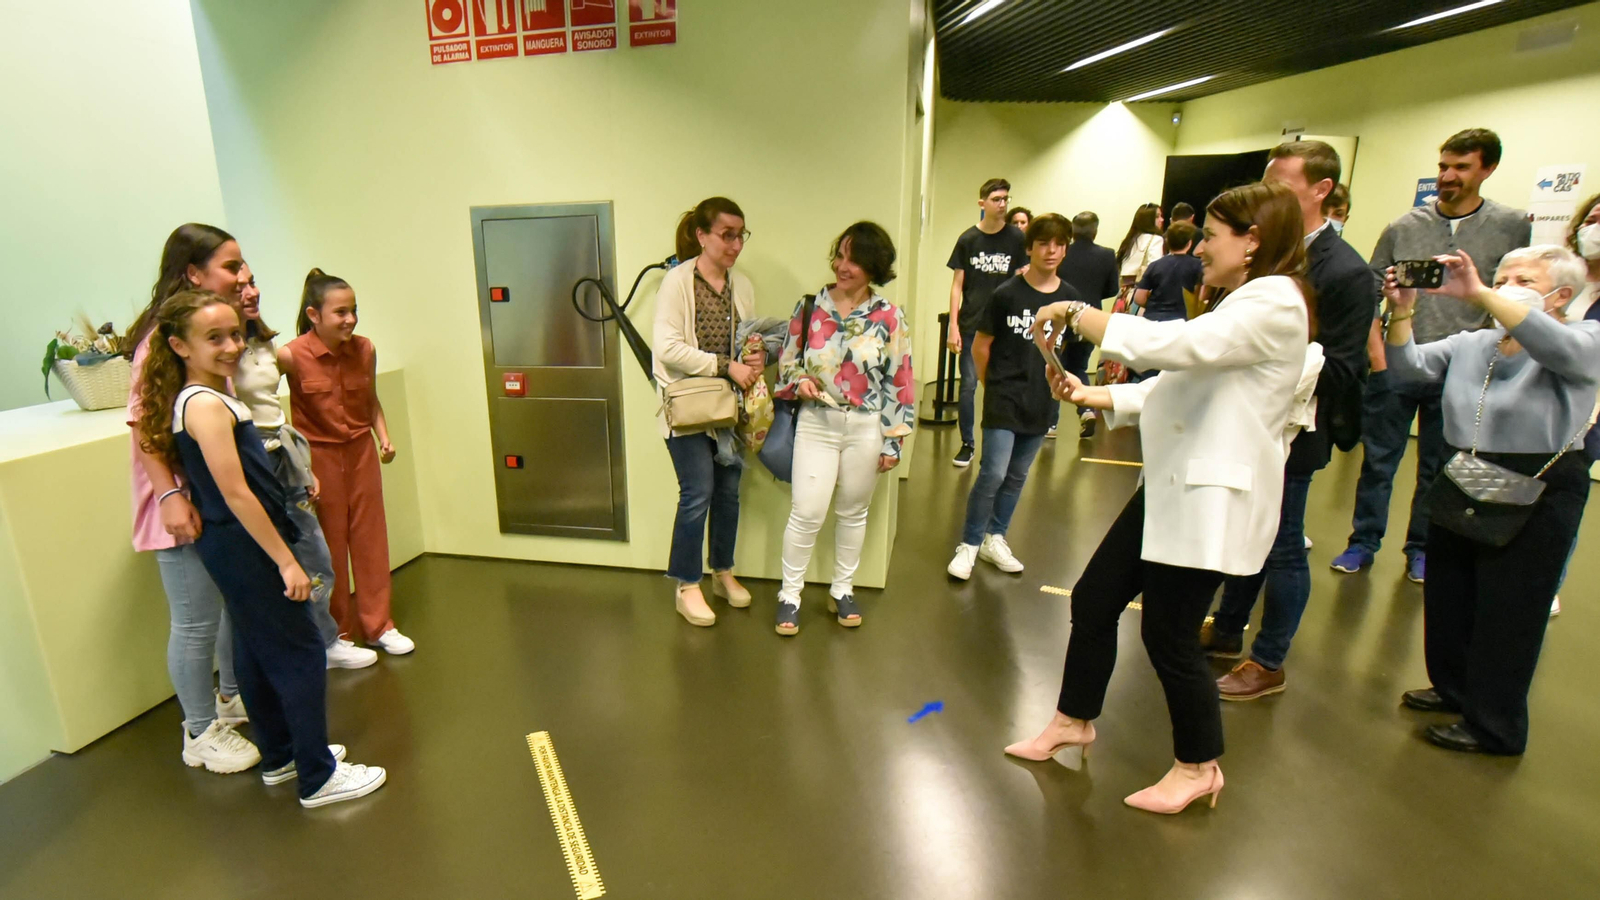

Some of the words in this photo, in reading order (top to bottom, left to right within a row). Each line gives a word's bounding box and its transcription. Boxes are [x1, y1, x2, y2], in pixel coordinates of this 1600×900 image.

[573, 29, 614, 41] AVISADOR
[634, 29, 671, 40] EXTINTOR
[433, 43, 468, 53] PULSADOR
[480, 43, 514, 53] EXTINTOR
[525, 37, 565, 50] MANGUERA
[576, 39, 612, 50] SONORO
[443, 52, 470, 61] ALARMA
[1536, 214, 1571, 222] IMPARES
[546, 769, 562, 797] MANTENGA
[554, 795, 564, 804] LA
[557, 803, 574, 832] DISTANCIA
[566, 831, 577, 841] DE
[569, 839, 589, 876] SEGURIDAD
